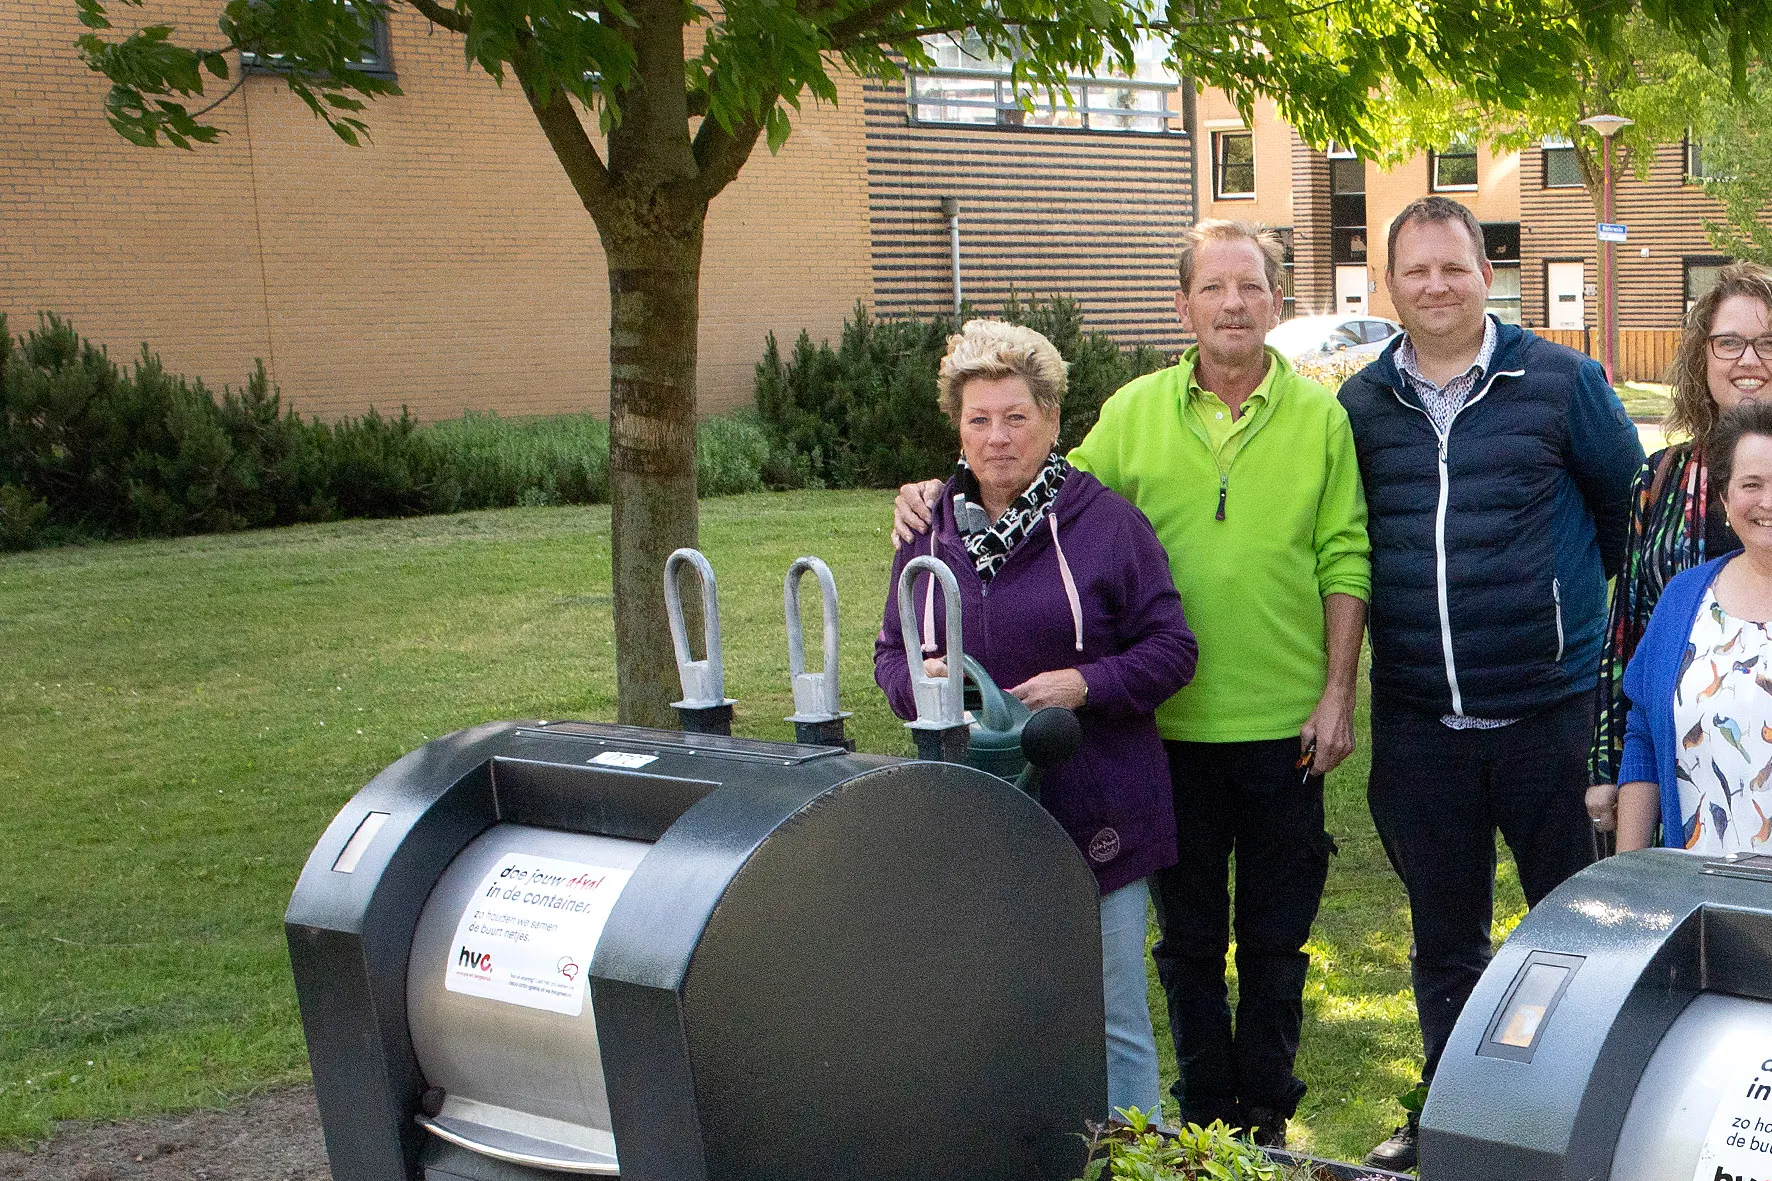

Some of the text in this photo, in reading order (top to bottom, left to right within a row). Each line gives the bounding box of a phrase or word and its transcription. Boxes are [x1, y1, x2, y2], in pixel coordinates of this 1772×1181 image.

[501, 865, 605, 890] doe jouw afval
[486, 881, 592, 914] in de container.
[468, 922, 479, 933] de
[481, 924, 502, 938] buurt
[474, 909, 557, 932] zo houden we samen
[458, 946, 493, 973] hvc.
[1747, 1077, 1770, 1100] in
[1732, 1116, 1750, 1129] zo
[1726, 1133, 1746, 1148] de
